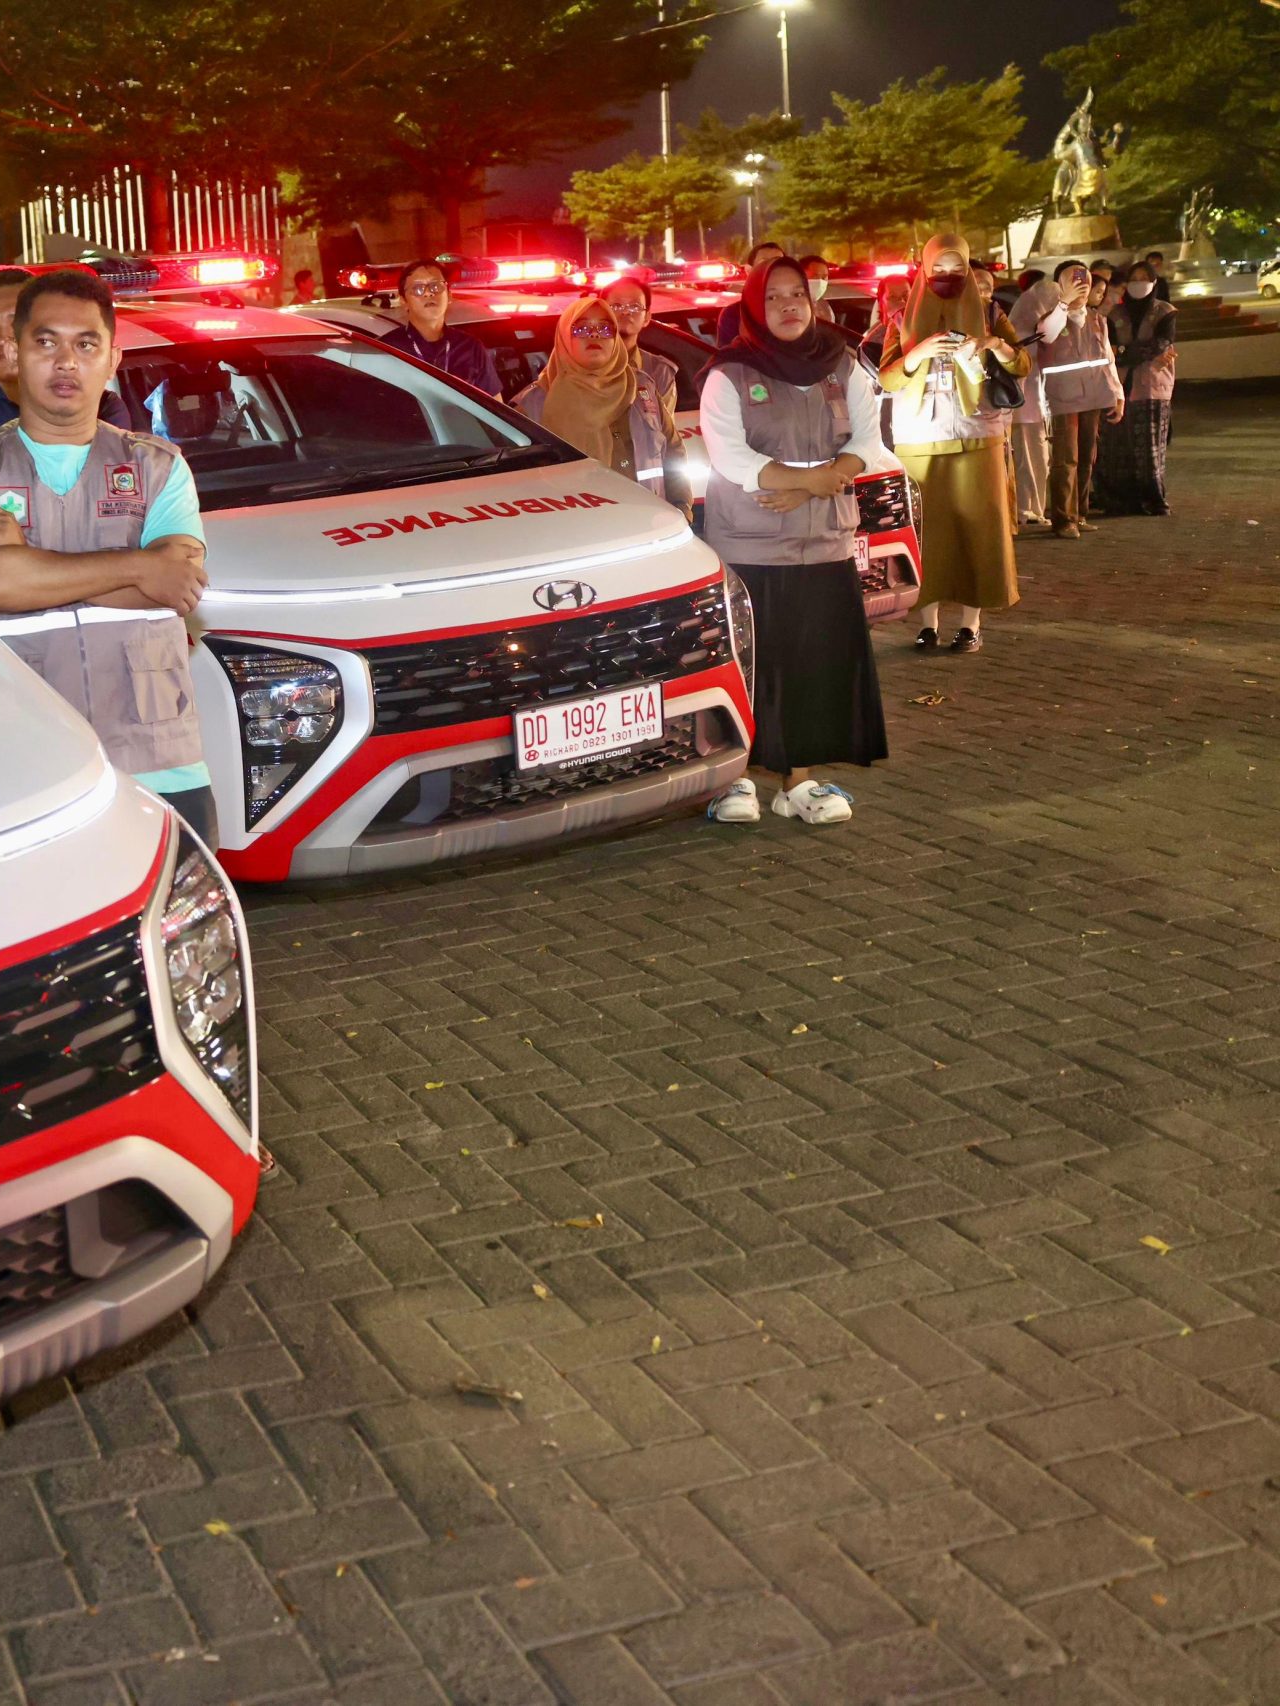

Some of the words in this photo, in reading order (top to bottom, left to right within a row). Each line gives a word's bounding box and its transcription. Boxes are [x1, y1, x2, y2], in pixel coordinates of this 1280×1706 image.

[522, 714, 548, 748] DD
[562, 702, 607, 740] 1992
[620, 691, 657, 727] EKA
[543, 743, 579, 758] RICHARD
[567, 754, 604, 767] HYUNDAI
[605, 747, 632, 759] GOWA
